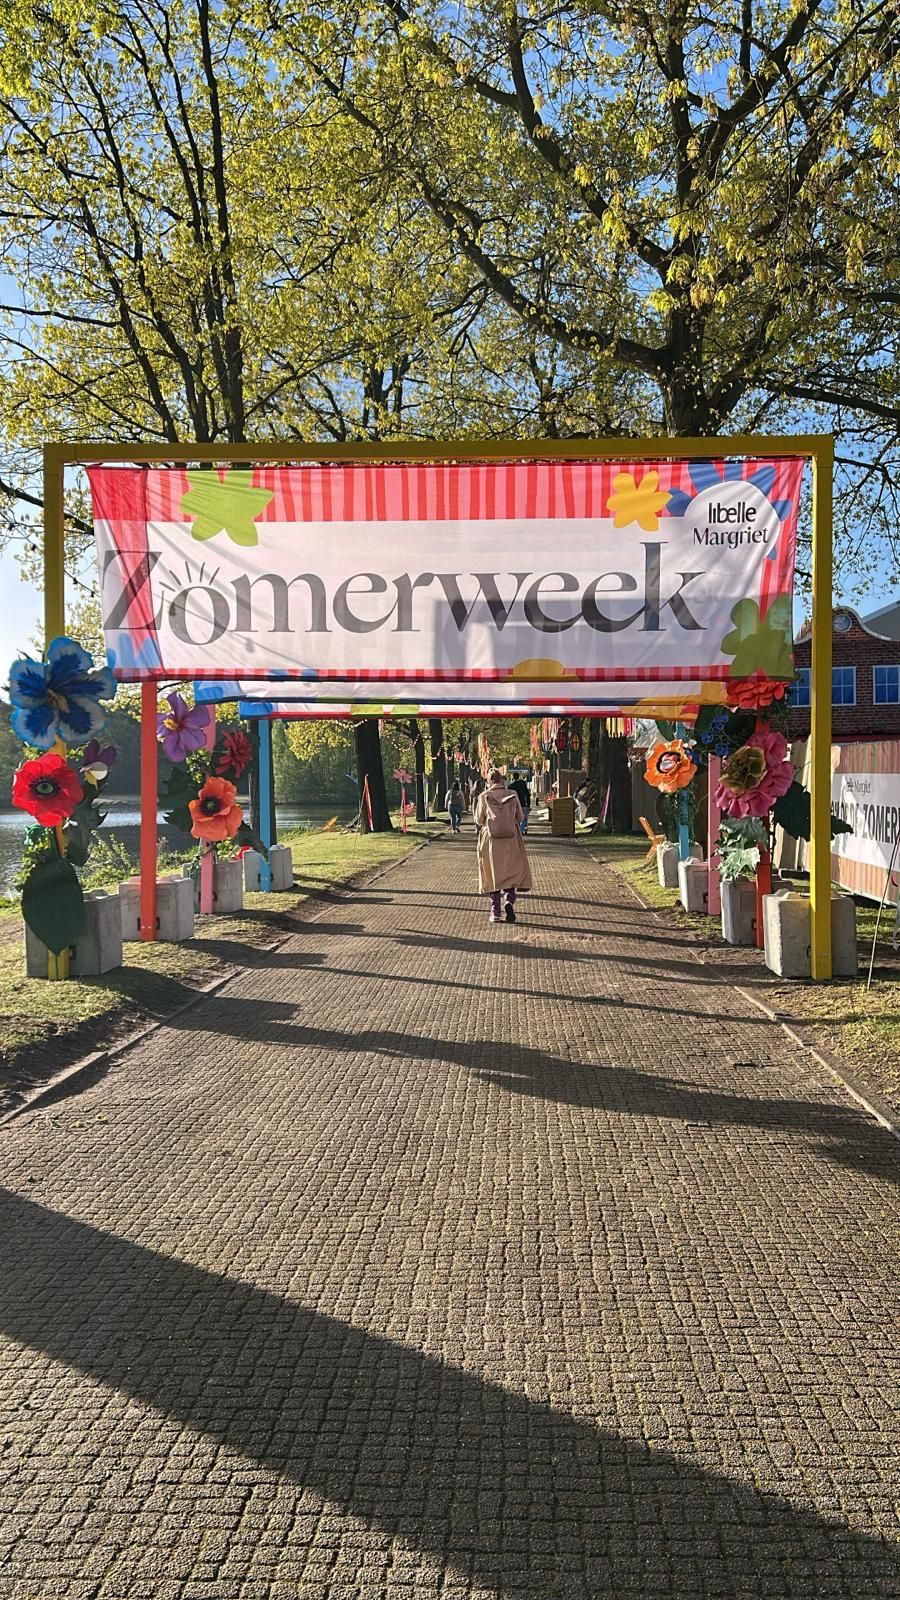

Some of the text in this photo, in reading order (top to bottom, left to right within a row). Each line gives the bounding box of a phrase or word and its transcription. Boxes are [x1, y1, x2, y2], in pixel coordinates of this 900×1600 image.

[708, 502, 757, 524] libelle
[693, 526, 769, 549] Margriet
[102, 541, 707, 646] Zomerweek
